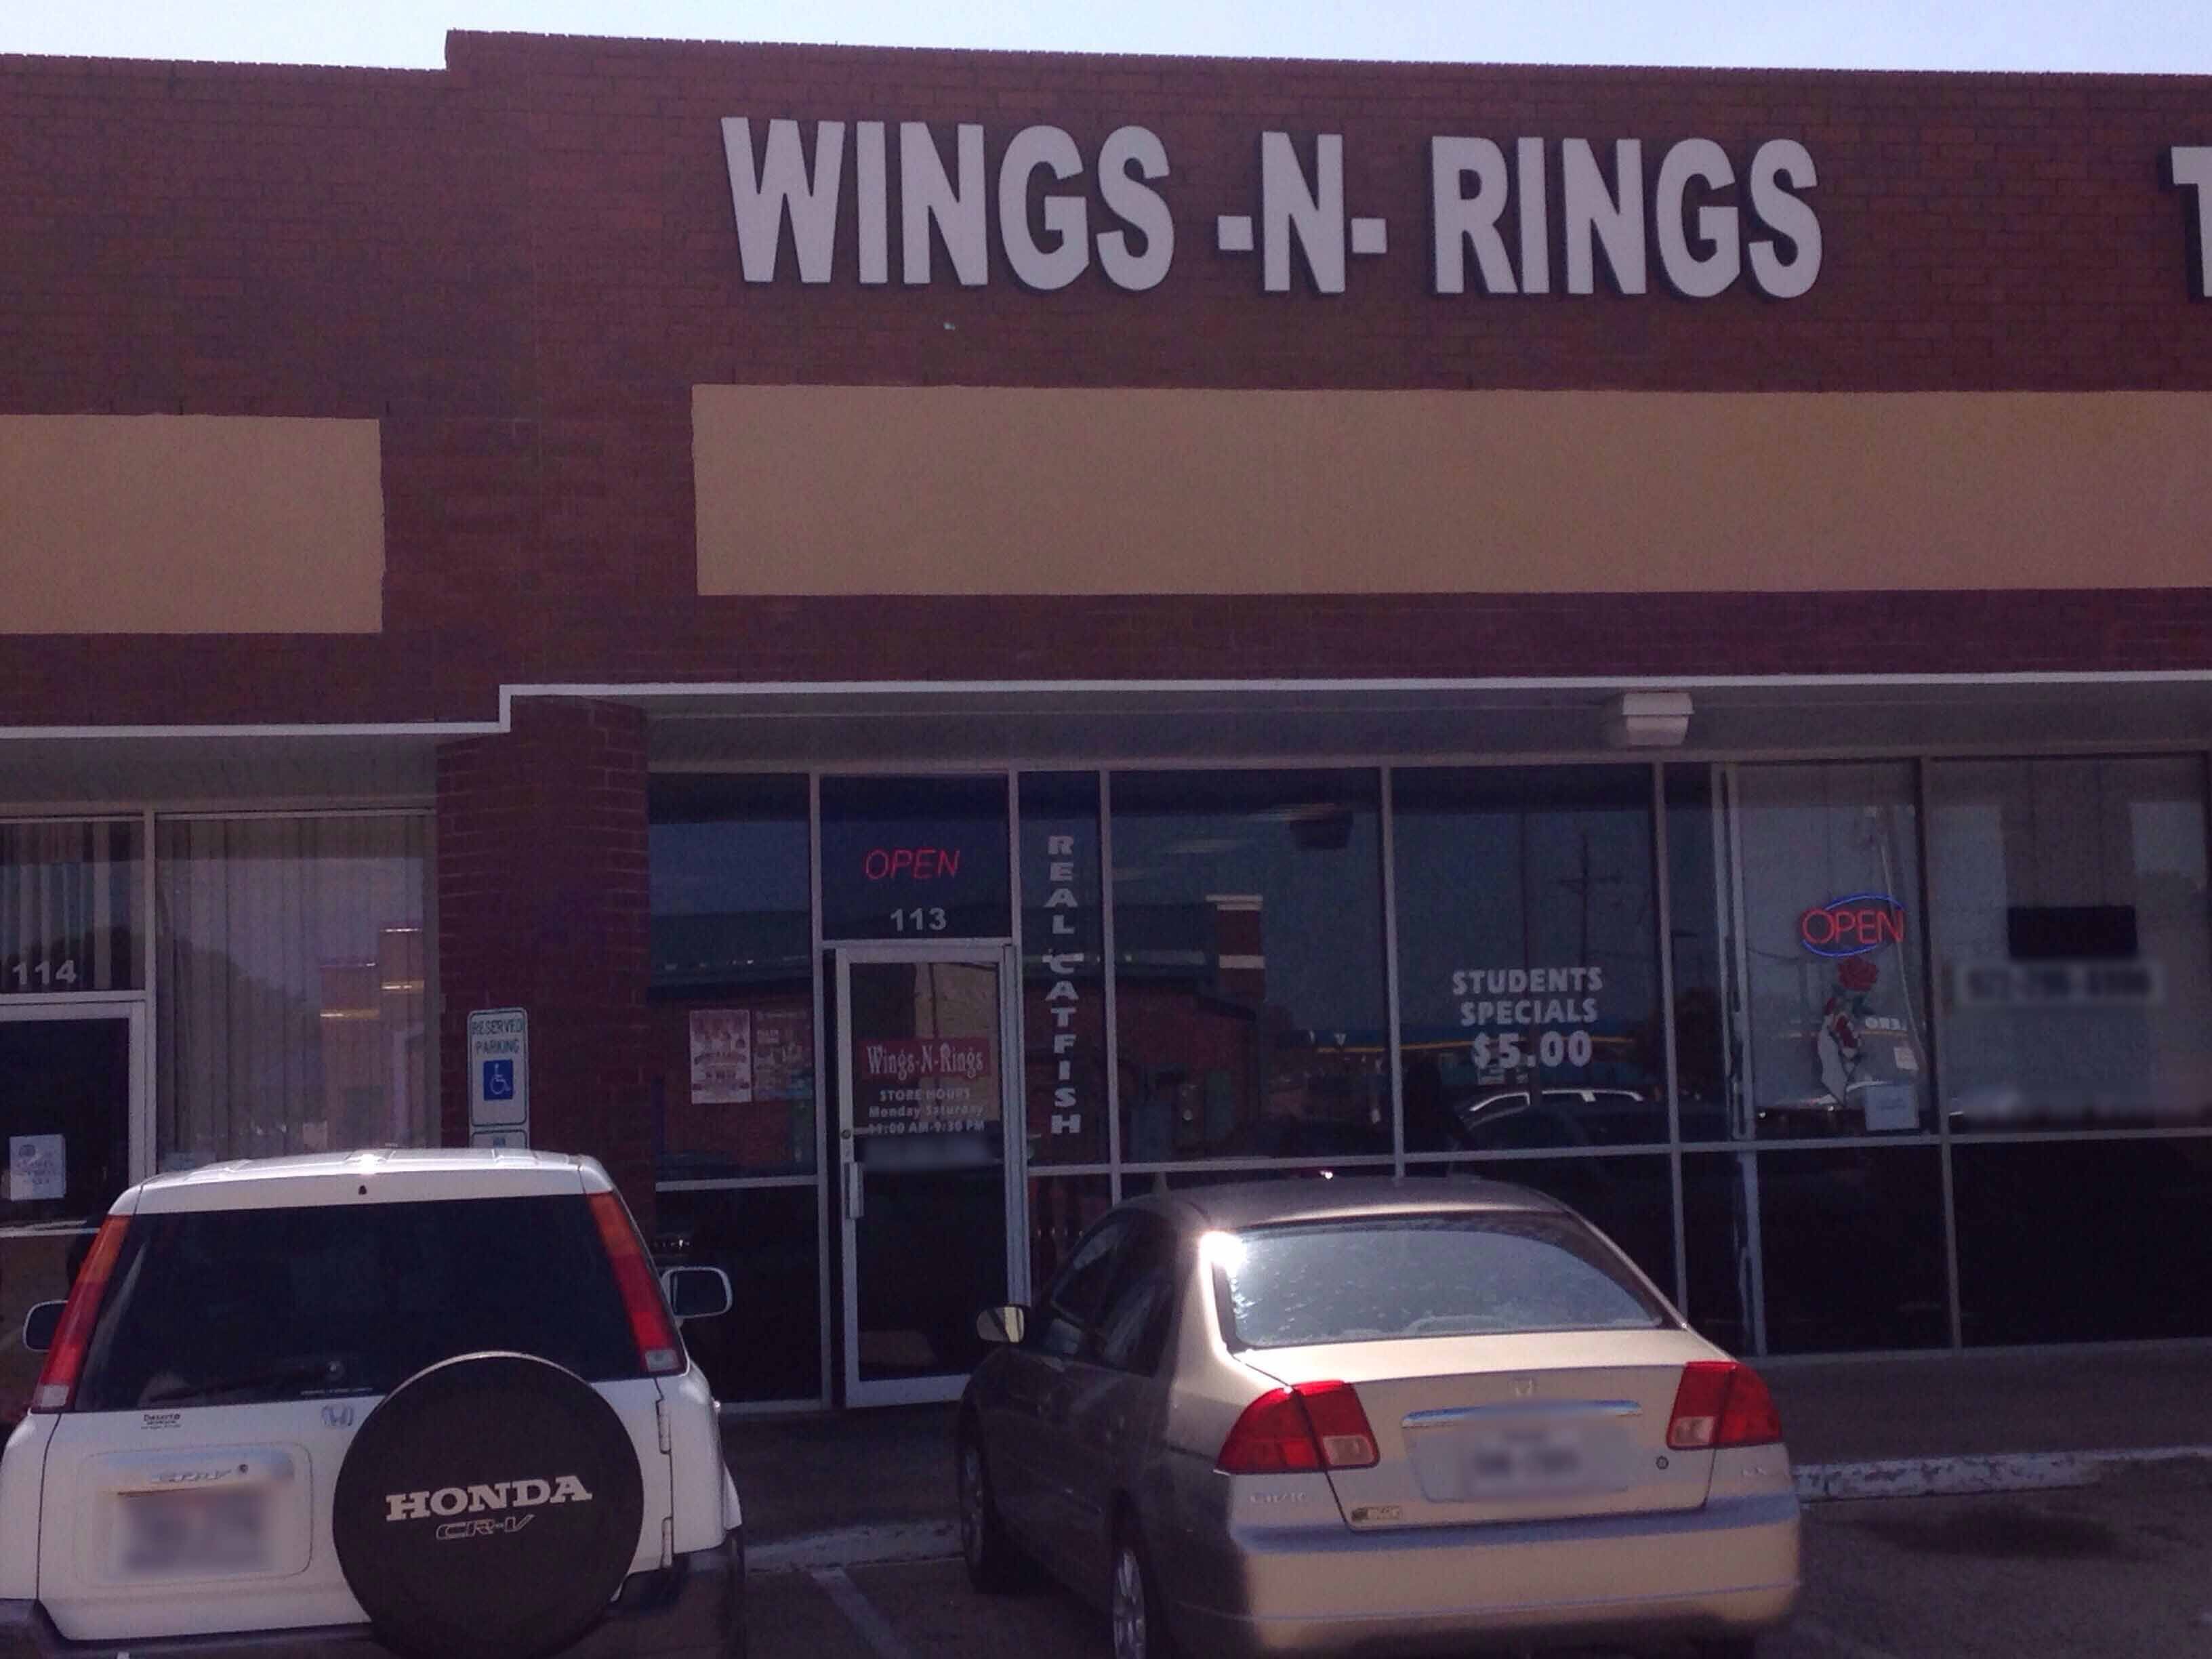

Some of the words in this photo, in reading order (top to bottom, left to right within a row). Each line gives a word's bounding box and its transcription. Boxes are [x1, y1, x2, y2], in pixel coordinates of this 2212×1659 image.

[721, 117, 1175, 291] WINGS
[1218, 131, 1387, 293] -N-
[1431, 135, 1823, 299] RINGS
[865, 846, 961, 880] OPEN
[1044, 835, 1078, 935] REAL
[890, 906, 947, 932] 113
[1801, 909, 1906, 944] OPEN
[12, 959, 77, 985] 114
[1452, 966, 1603, 996] STUDENTS
[470, 1018, 525, 1036] RESERVED
[1460, 998, 1599, 1027] SPECIALS
[476, 1039, 520, 1054] PARKING
[1044, 951, 1082, 1134] CATFISH
[1473, 1029, 1593, 1070] $5.00
[879, 1088, 922, 1102] STORE
[385, 1474, 594, 1522] HONDA
[434, 1513, 536, 1540] CR-V
